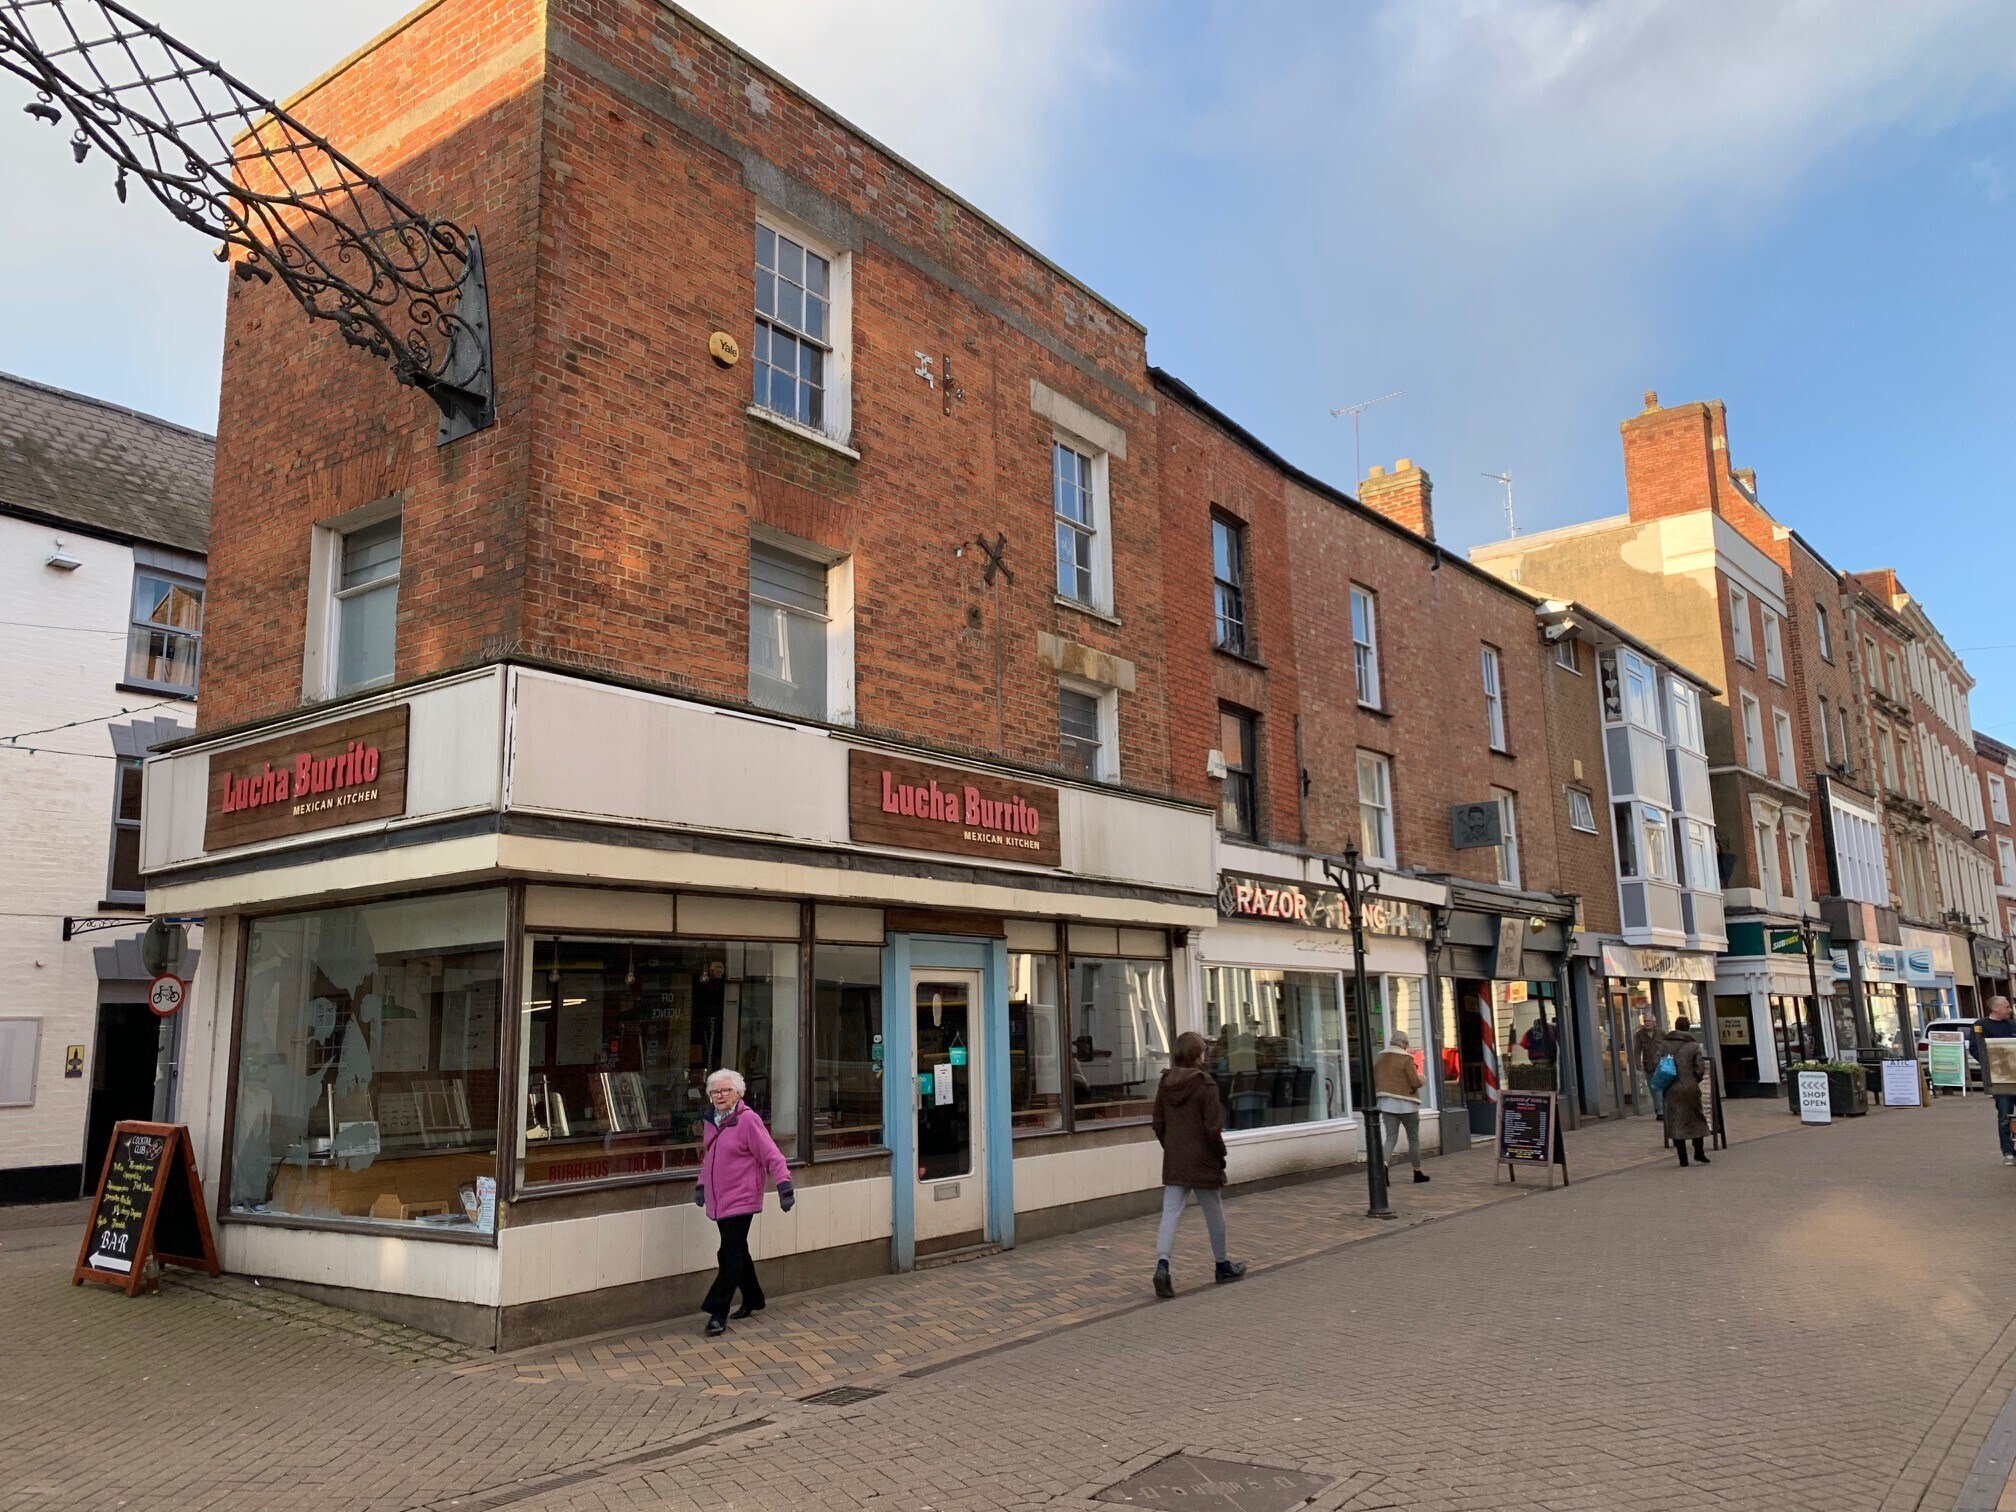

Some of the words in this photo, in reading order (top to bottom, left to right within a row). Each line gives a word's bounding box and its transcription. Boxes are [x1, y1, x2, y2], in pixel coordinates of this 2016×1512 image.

[719, 339, 738, 357] Yale
[222, 762, 289, 813] Lucha
[294, 741, 379, 798] Burrito
[292, 798, 333, 816] MEXICAN
[336, 789, 378, 807] KITCHEN
[882, 771, 960, 823] Lucha
[964, 786, 1040, 835] Burrito
[964, 831, 1003, 845] MEXICAN
[1005, 837, 1040, 850] KITCHEN
[1234, 885, 1308, 920] RAZOR
[1340, 900, 1387, 929] NG
[134, 1145, 146, 1154] CLUB
[549, 1161, 609, 1182] BURRITOS
[101, 1231, 129, 1254] BAR
